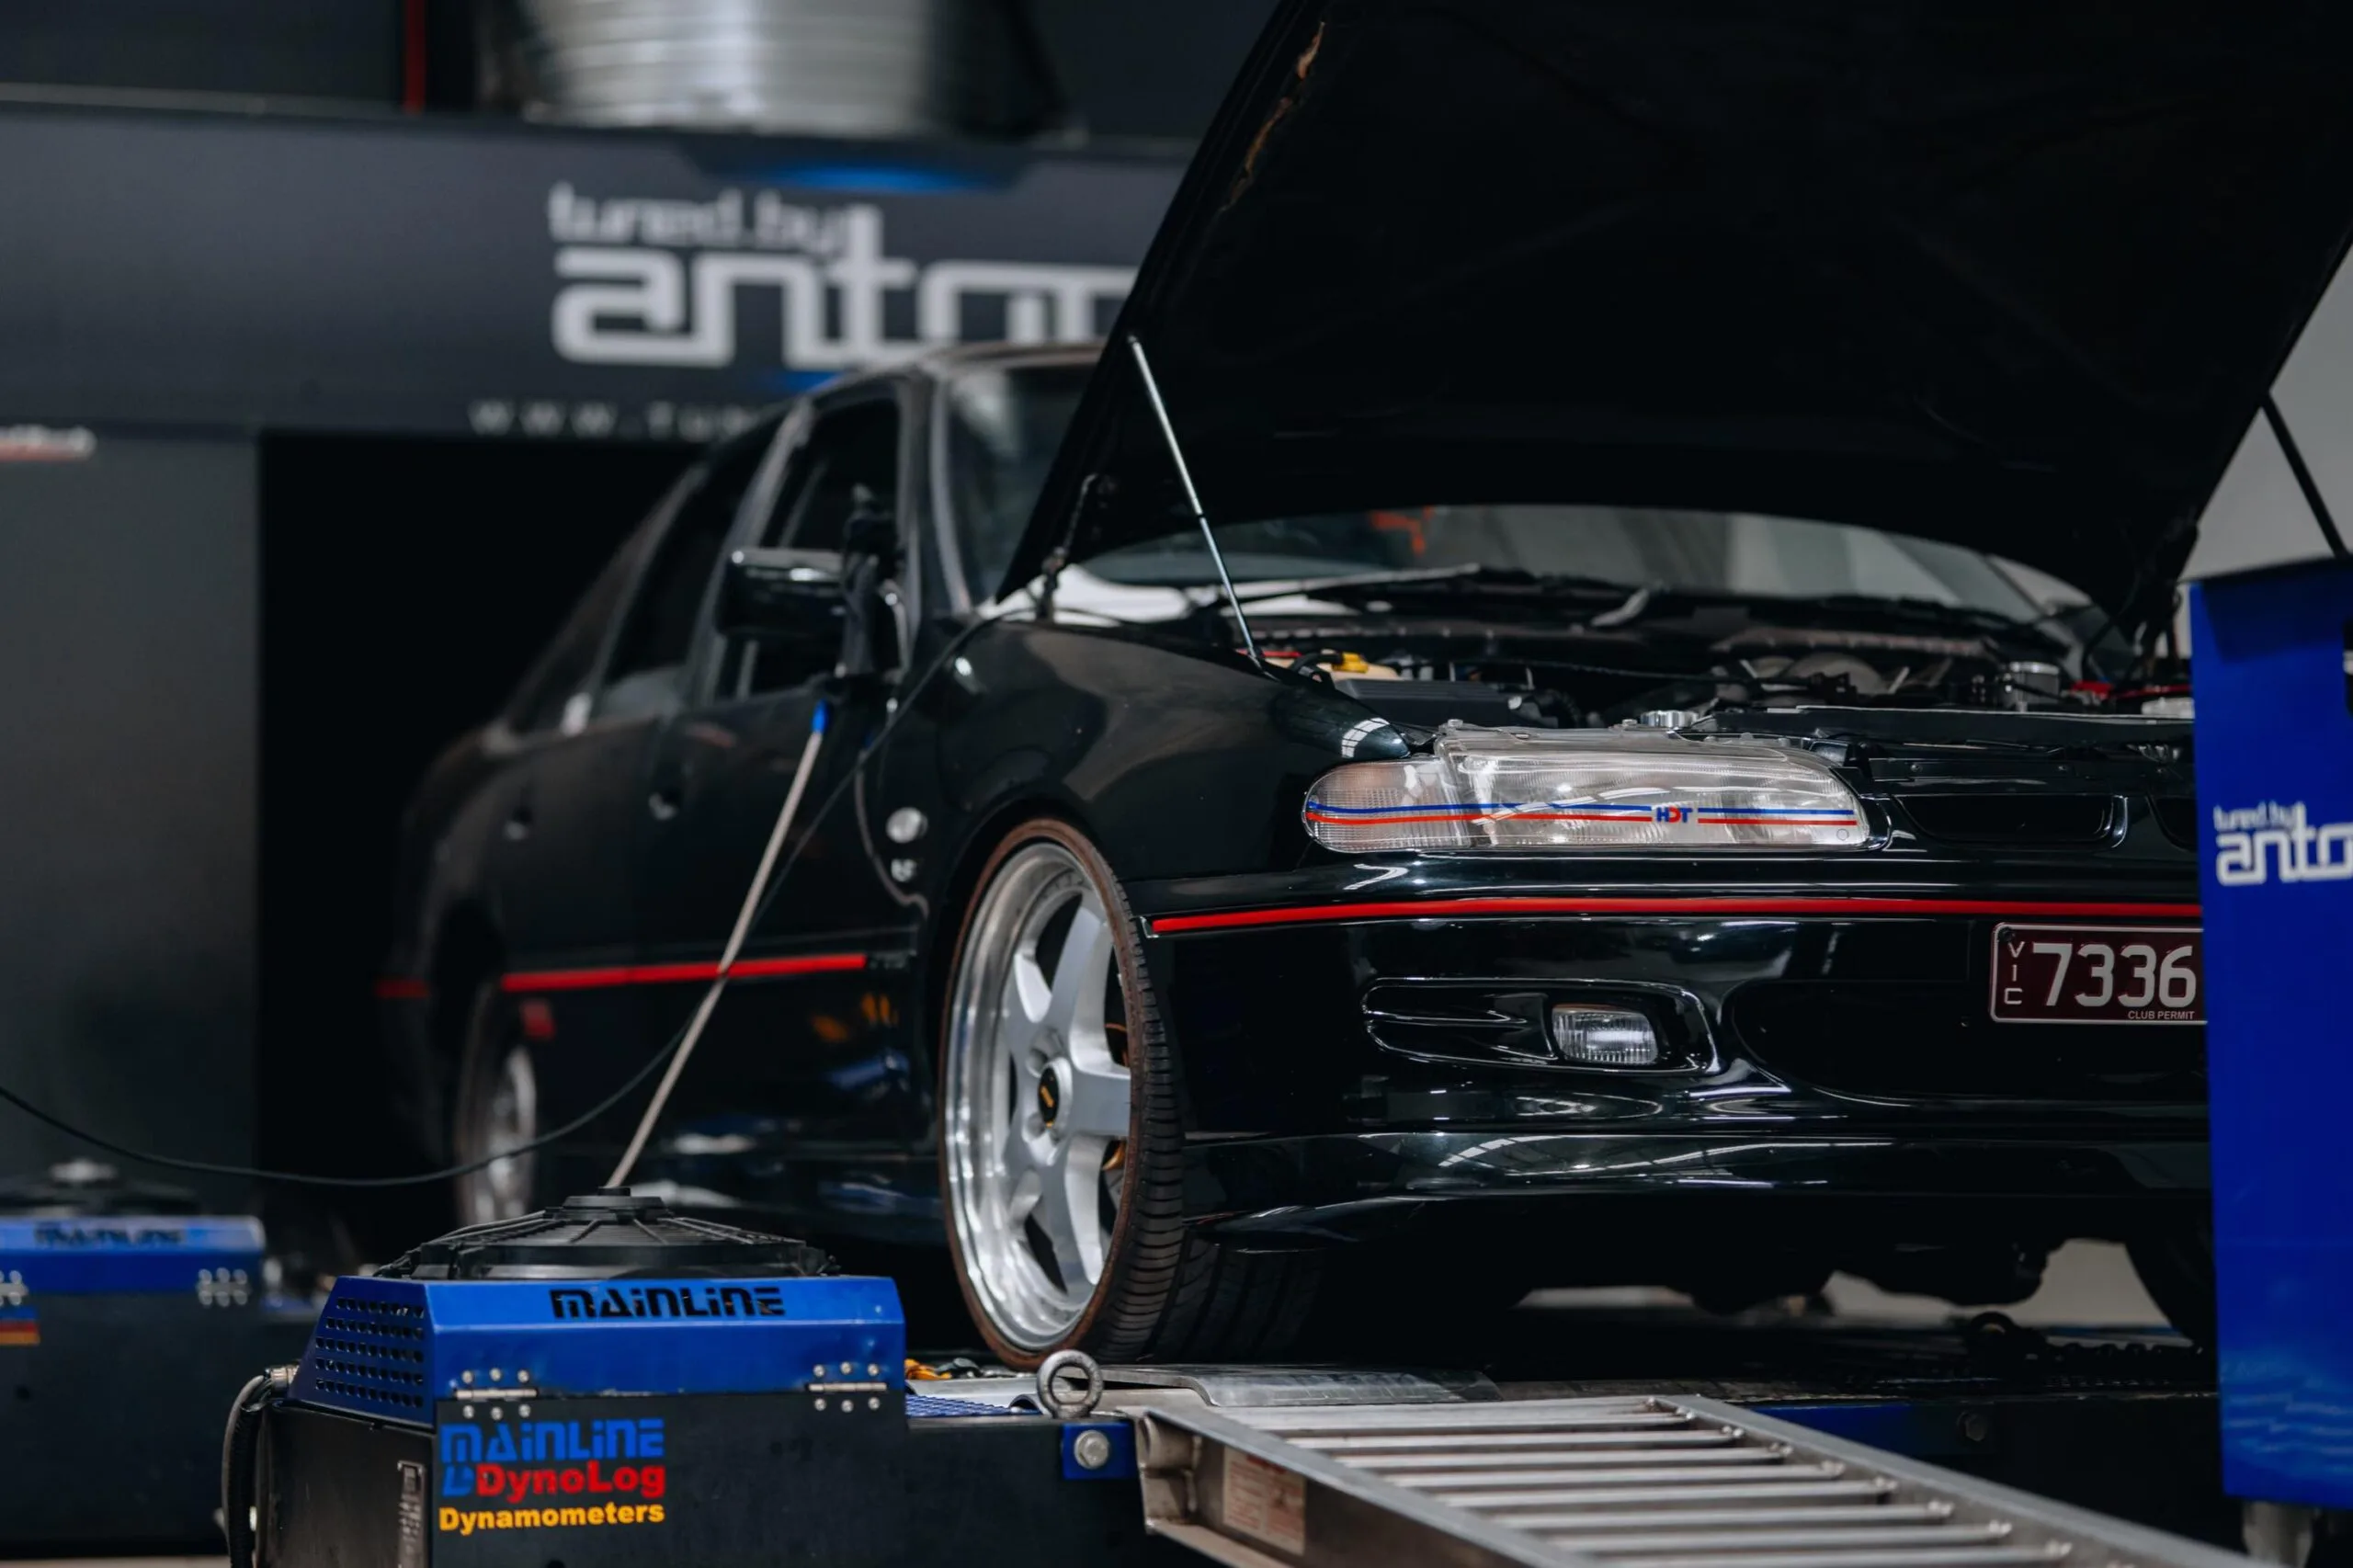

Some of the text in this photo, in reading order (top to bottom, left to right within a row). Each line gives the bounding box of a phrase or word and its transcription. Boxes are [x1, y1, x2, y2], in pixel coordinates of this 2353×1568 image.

[1655, 805, 1693, 824] HDT
[2032, 942, 2197, 1008] 7336
[2128, 1010, 2196, 1020] CLUB PERMIT
[475, 1460, 665, 1504] DynoLog
[438, 1501, 665, 1536] Dynamometers
